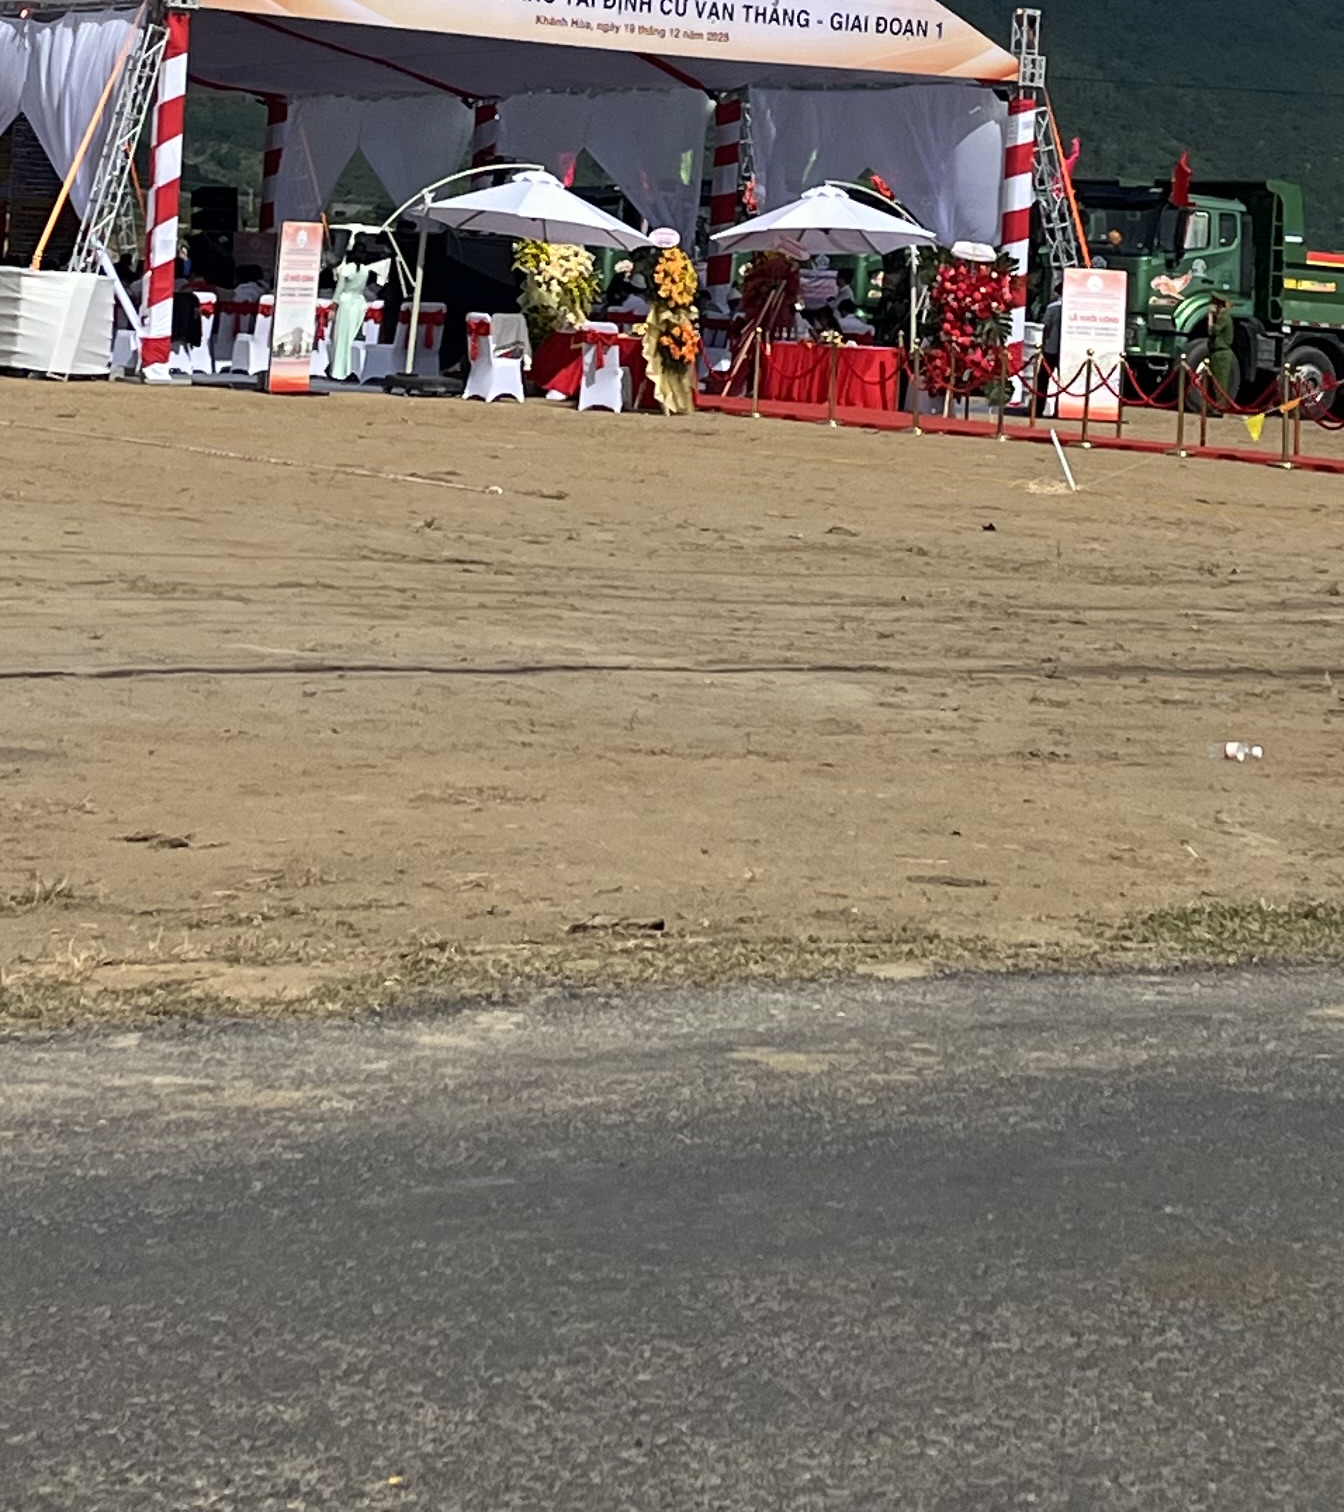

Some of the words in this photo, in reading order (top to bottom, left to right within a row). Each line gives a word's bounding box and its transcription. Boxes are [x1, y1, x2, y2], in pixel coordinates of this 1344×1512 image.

[695, 0, 734, 24] VẠN
[742, 0, 810, 28] THẮNG
[830, 12, 869, 33] GIAI
[875, 16, 928, 41] ĐOẠN
[935, 21, 943, 40] 1
